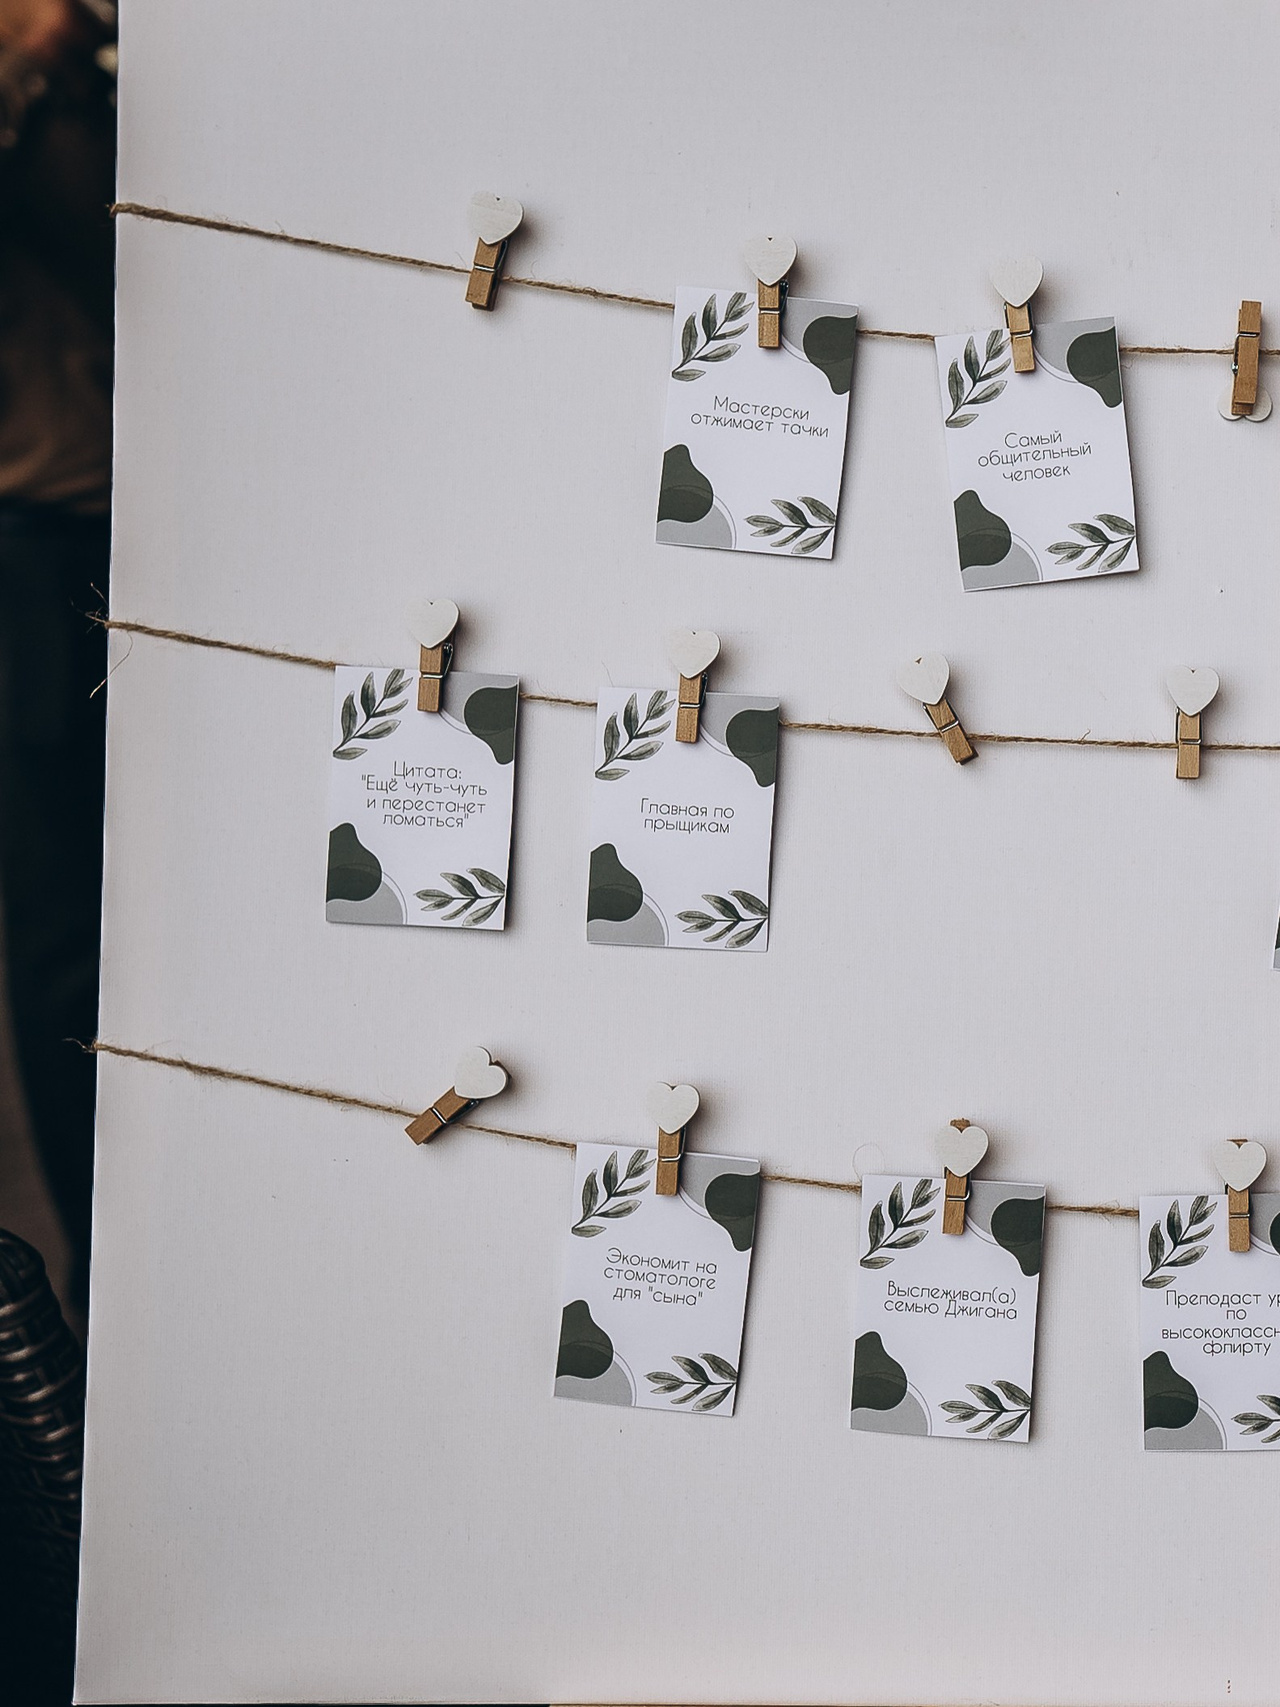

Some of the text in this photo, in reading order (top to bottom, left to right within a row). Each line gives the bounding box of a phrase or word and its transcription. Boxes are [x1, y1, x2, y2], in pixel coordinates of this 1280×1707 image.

[714, 396, 809, 419] Мастерски
[691, 413, 828, 437] отжимает тачки
[1005, 430, 1062, 448] Самый
[978, 443, 1091, 465] общительный
[1003, 463, 1070, 481] человек
[394, 761, 461, 780] Цитата:
[362, 775, 487, 798] "Ещё чуть-чуть
[367, 797, 486, 815] и перестанет
[641, 798, 734, 819] Главная по
[383, 813, 469, 828] ломаться"
[644, 817, 730, 834] прыщикам
[606, 1247, 717, 1274] Экономит на
[604, 1266, 716, 1289] стоматологе
[613, 1287, 703, 1306] для "сына"
[888, 1280, 1016, 1304] Выслеживал(а)
[1166, 1290, 1261, 1308] Преподаст
[884, 1300, 1017, 1320] семью Джигана
[1226, 1309, 1246, 1320] по
[1203, 1341, 1271, 1356] флирту
